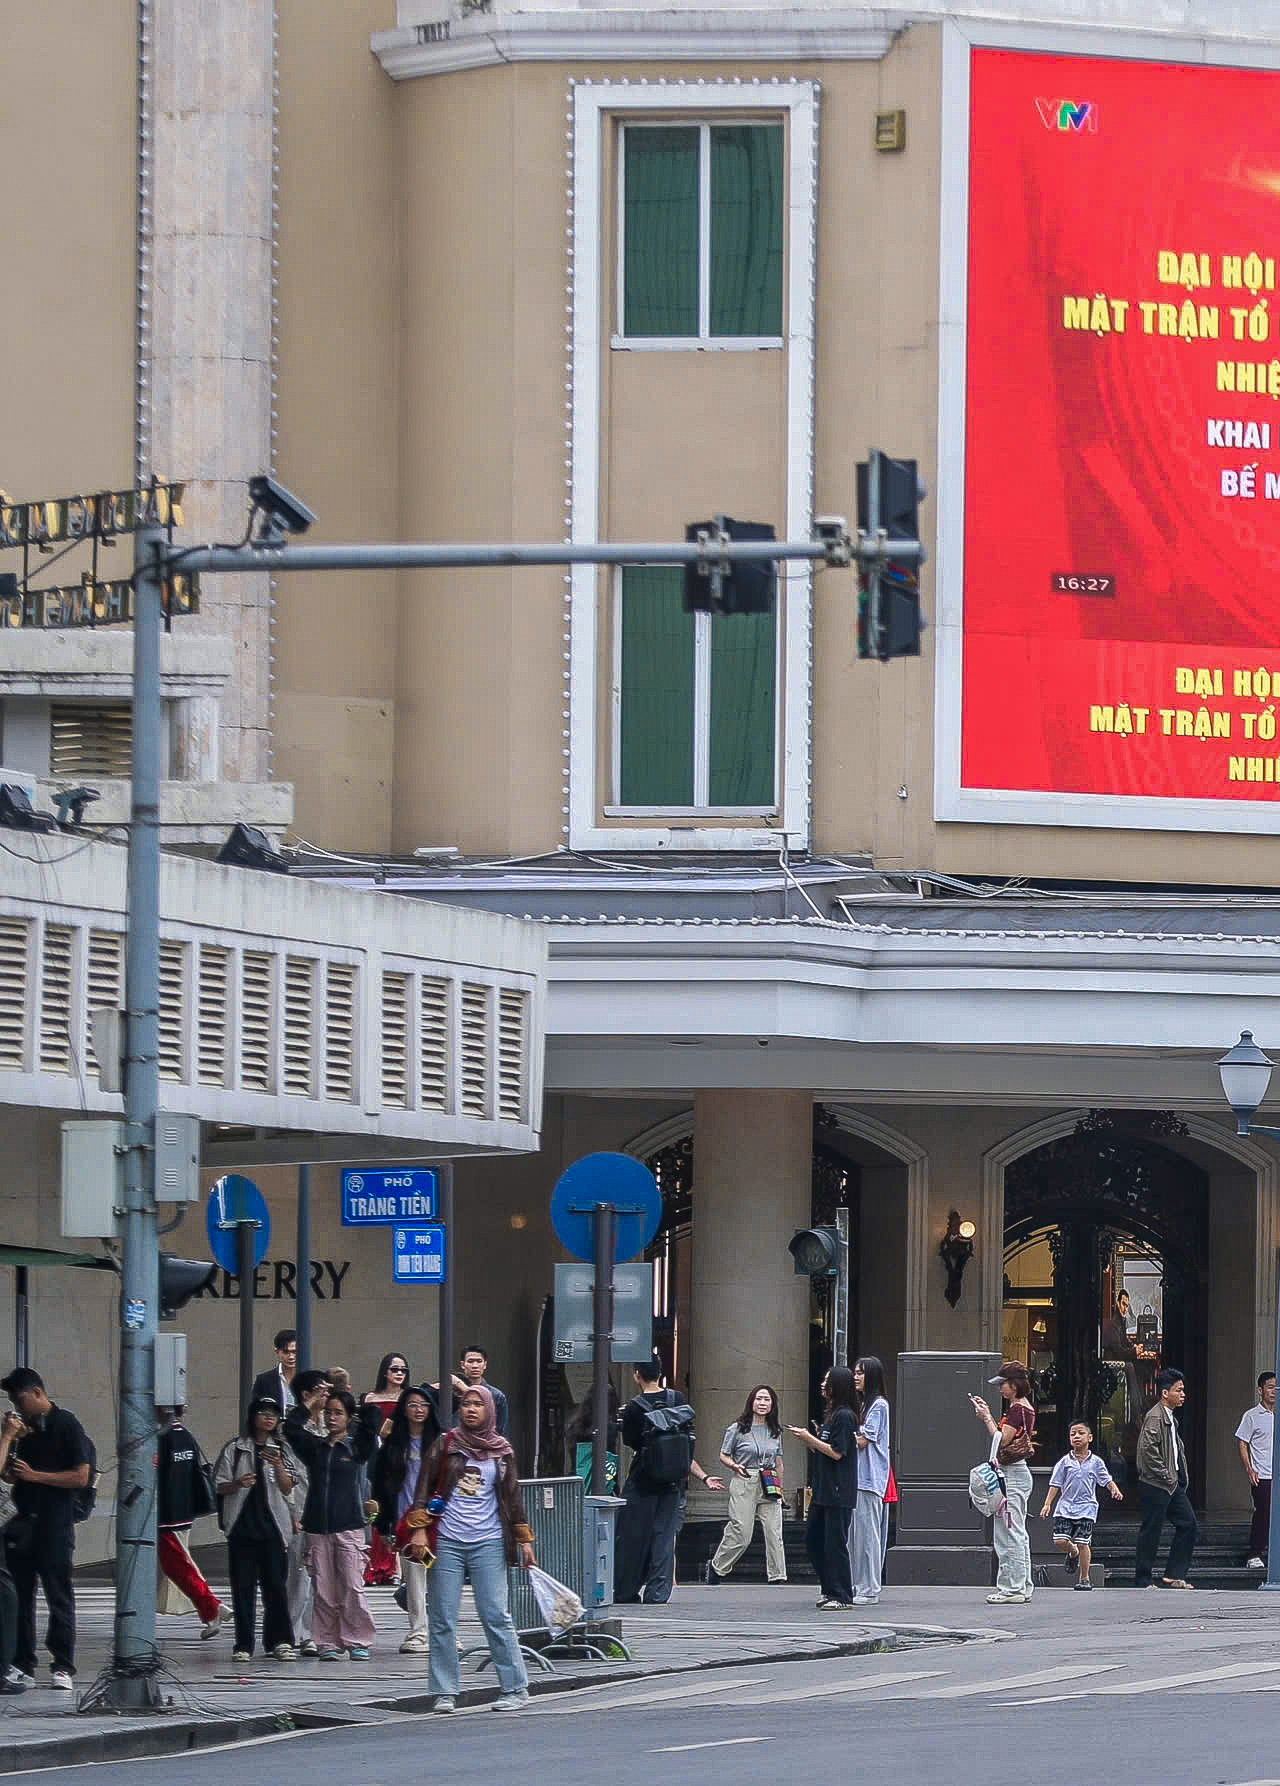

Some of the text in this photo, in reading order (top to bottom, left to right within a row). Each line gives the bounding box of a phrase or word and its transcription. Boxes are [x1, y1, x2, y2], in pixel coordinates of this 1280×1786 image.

[1158, 250, 1211, 291] ĐẠI
[1222, 252, 1276, 296] HỘI
[1063, 293, 1129, 339] MẶT
[1139, 299, 1220, 343] TRẬN
[1230, 298, 1269, 342] TỔ
[1206, 419, 1271, 449] KHAI
[1220, 463, 1259, 498] BẾ
[1058, 577, 1110, 591] 16:27
[1175, 667, 1224, 700] ĐẠI
[1090, 702, 1150, 738] MẶT
[1159, 706, 1231, 742] TRẬN
[1241, 704, 1276, 741] TỔ
[384, 1173, 413, 1187] PHỐ
[349, 1189, 431, 1217] TRÀNG TIỀN
[415, 1231, 431, 1245] PHỐ
